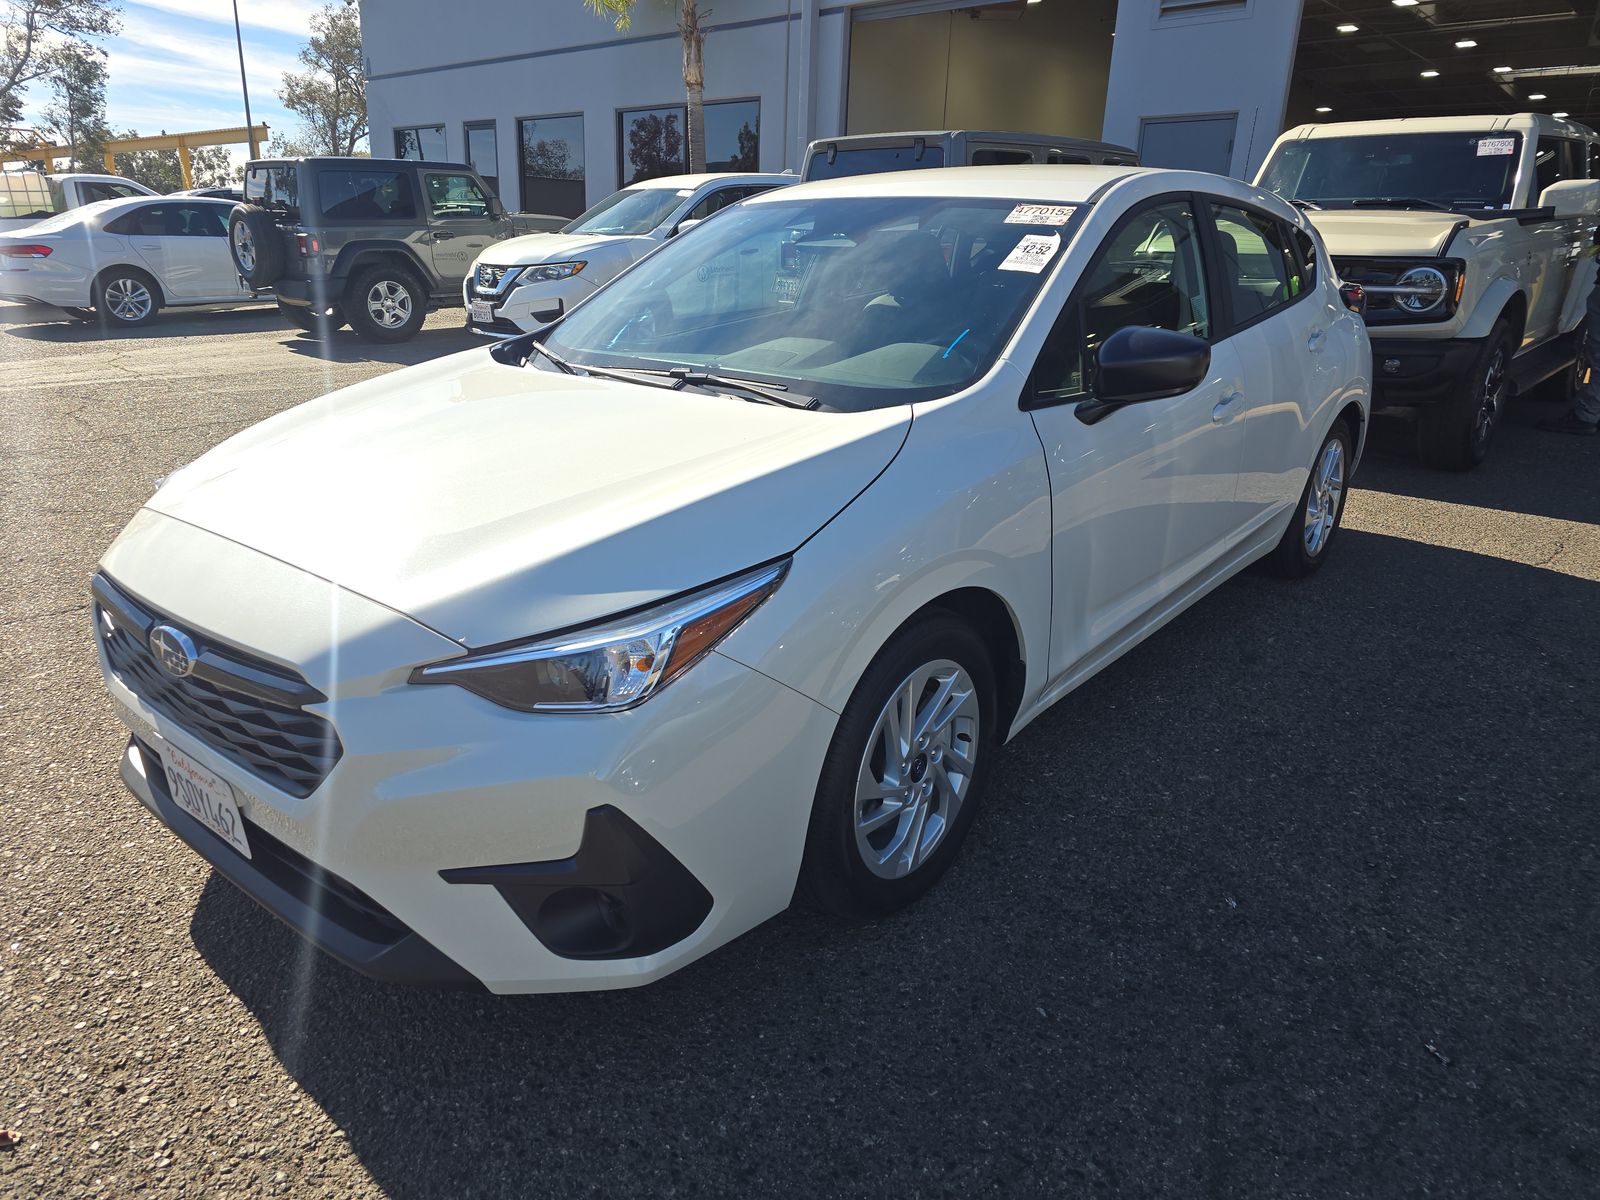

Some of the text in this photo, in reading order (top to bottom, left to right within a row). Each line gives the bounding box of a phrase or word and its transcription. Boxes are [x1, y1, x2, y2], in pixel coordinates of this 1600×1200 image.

[1015, 206, 1074, 216] 4770152
[1022, 245, 1051, 255] 12:52
[170, 750, 214, 788] California
[168, 765, 242, 845] 9SDY462
